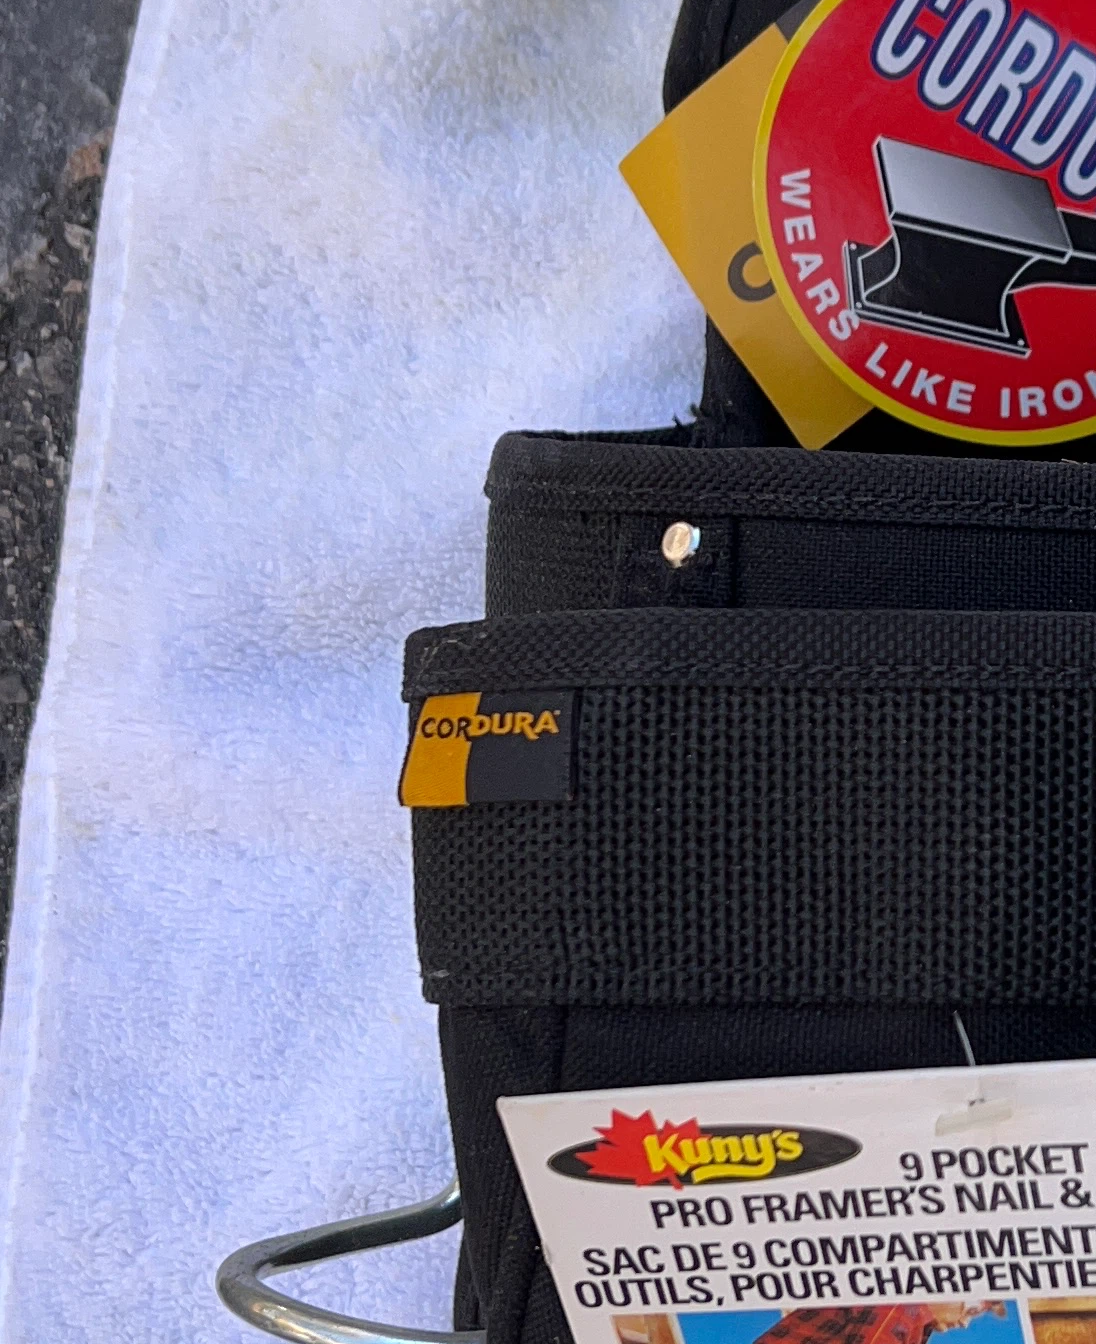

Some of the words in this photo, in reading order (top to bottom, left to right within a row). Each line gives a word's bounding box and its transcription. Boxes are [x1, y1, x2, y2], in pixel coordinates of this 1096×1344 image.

[780, 168, 860, 342] WEARS
[865, 342, 976, 414] LIKE
[643, 1130, 804, 1183] Kuny's
[900, 1153, 923, 1180] 9
[933, 1142, 1089, 1179] POCKET
[650, 1196, 734, 1228] PRO
[742, 1186, 945, 1223] FRAMER'S
[956, 1178, 1055, 1214] NAIL
[1060, 1179, 1094, 1208] &
[582, 1245, 665, 1277] SAC
[671, 1242, 729, 1272] DE
[736, 1241, 758, 1269] 9
[575, 1274, 724, 1309] OUTILS,
[731, 1271, 840, 1302] POUR
